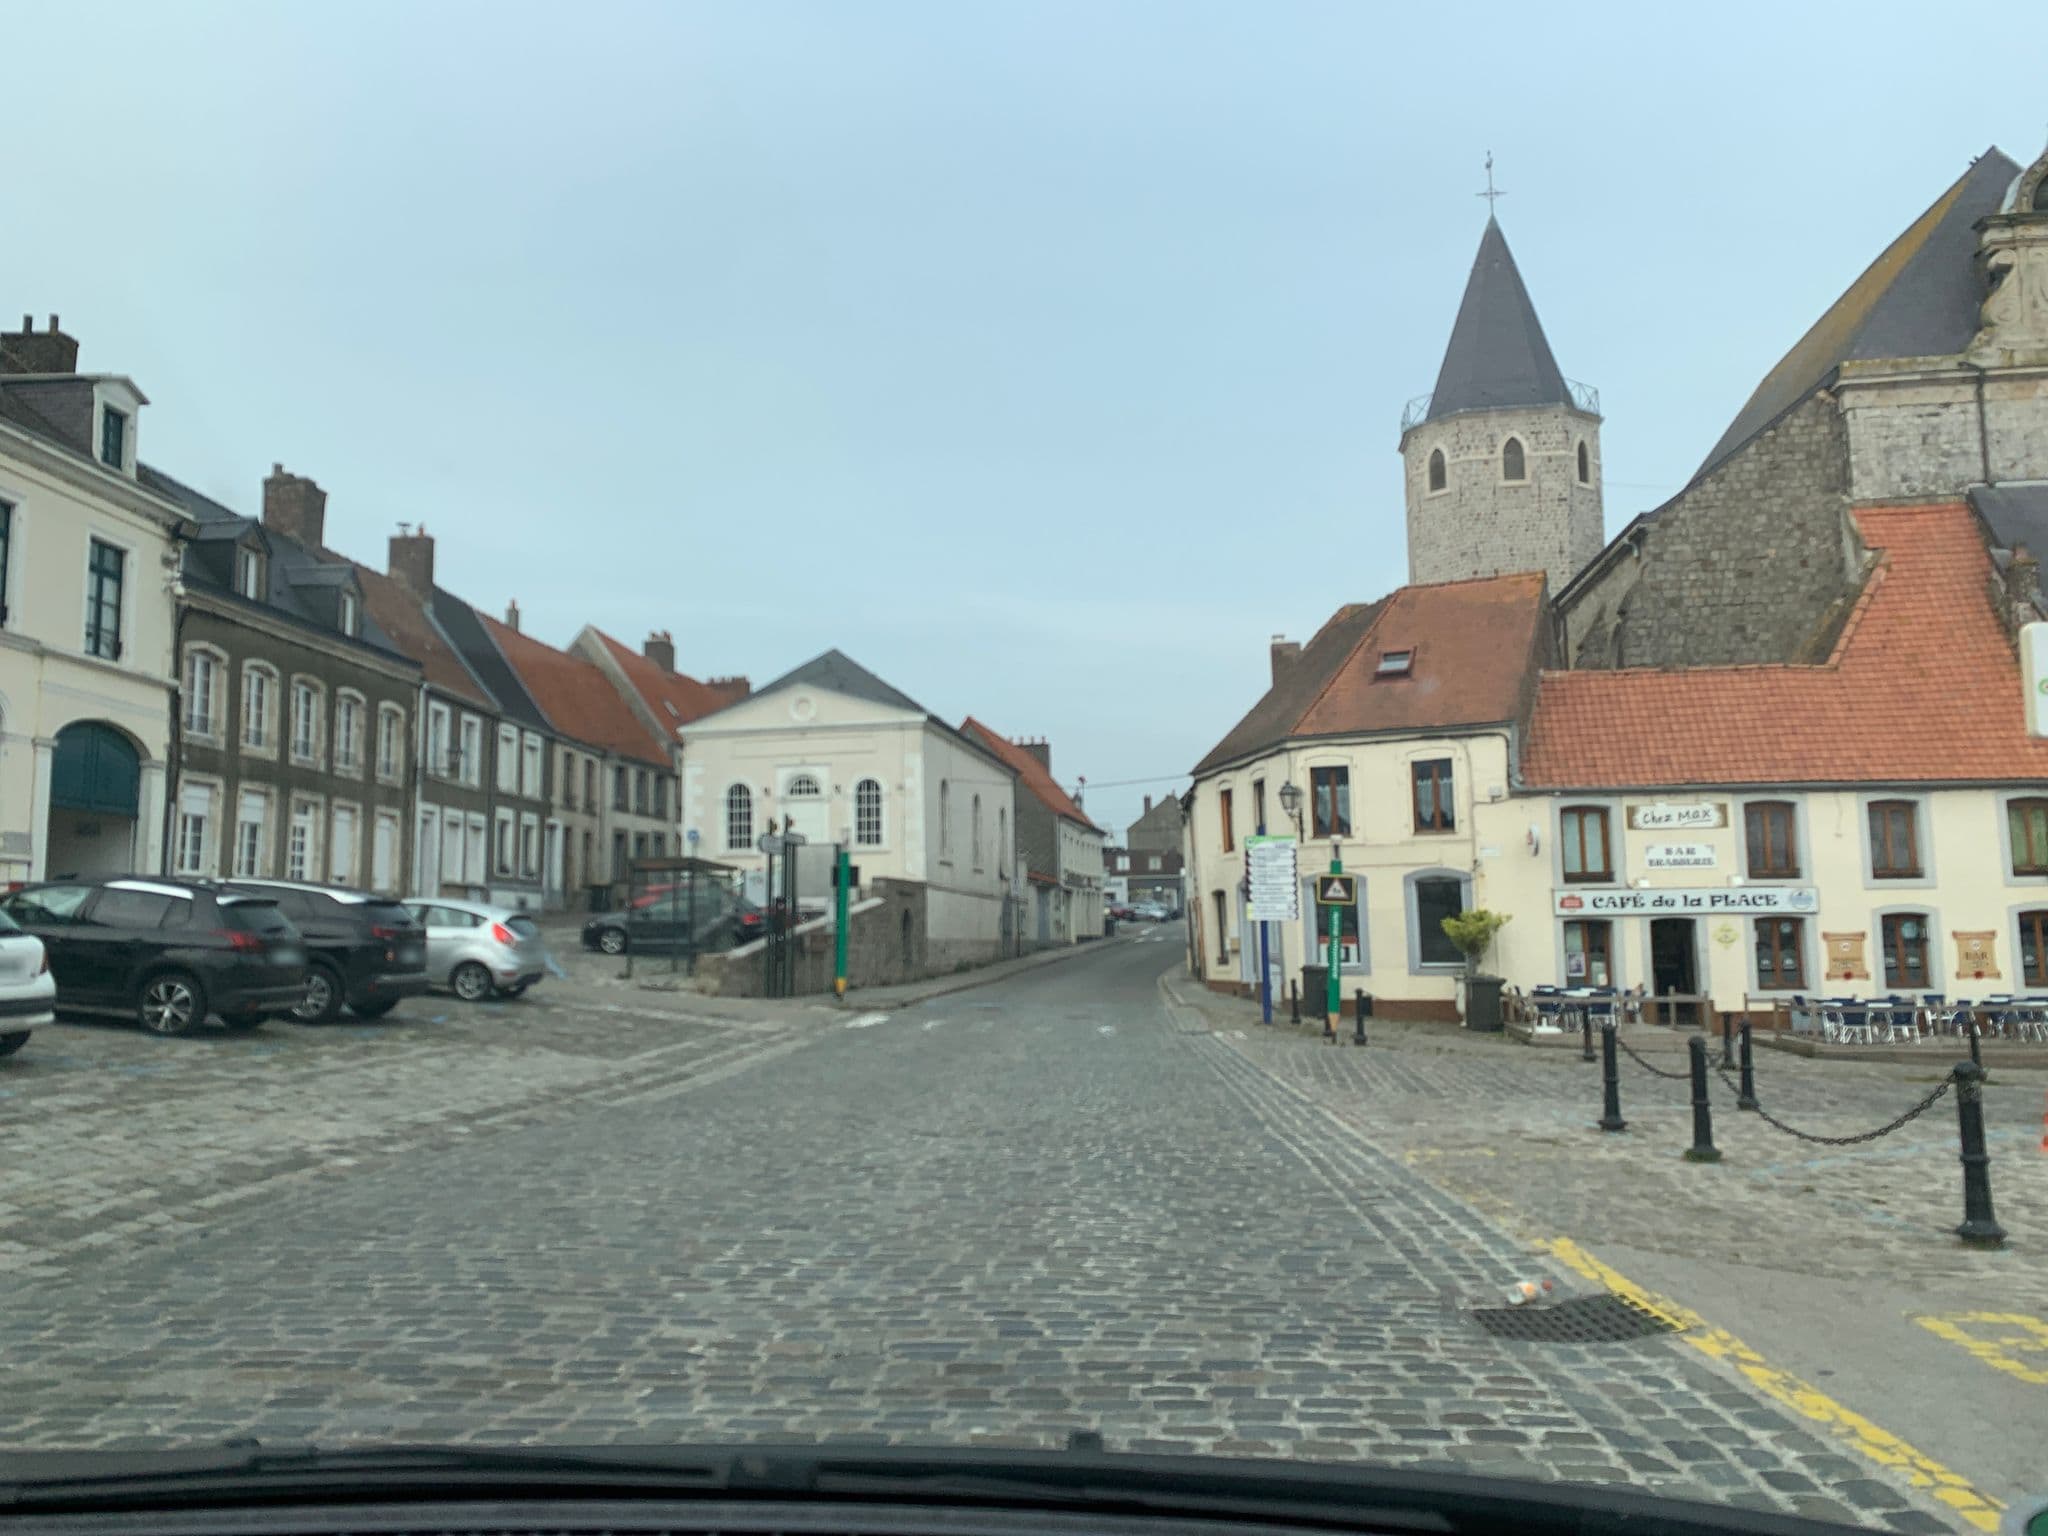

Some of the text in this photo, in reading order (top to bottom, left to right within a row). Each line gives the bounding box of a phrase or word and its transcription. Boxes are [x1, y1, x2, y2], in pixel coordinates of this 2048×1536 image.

[1643, 808, 1711, 824] Chez Max
[1592, 893, 1645, 909] CAFÉ
[1683, 894, 1702, 907] la
[1710, 894, 1778, 907] PLACE
